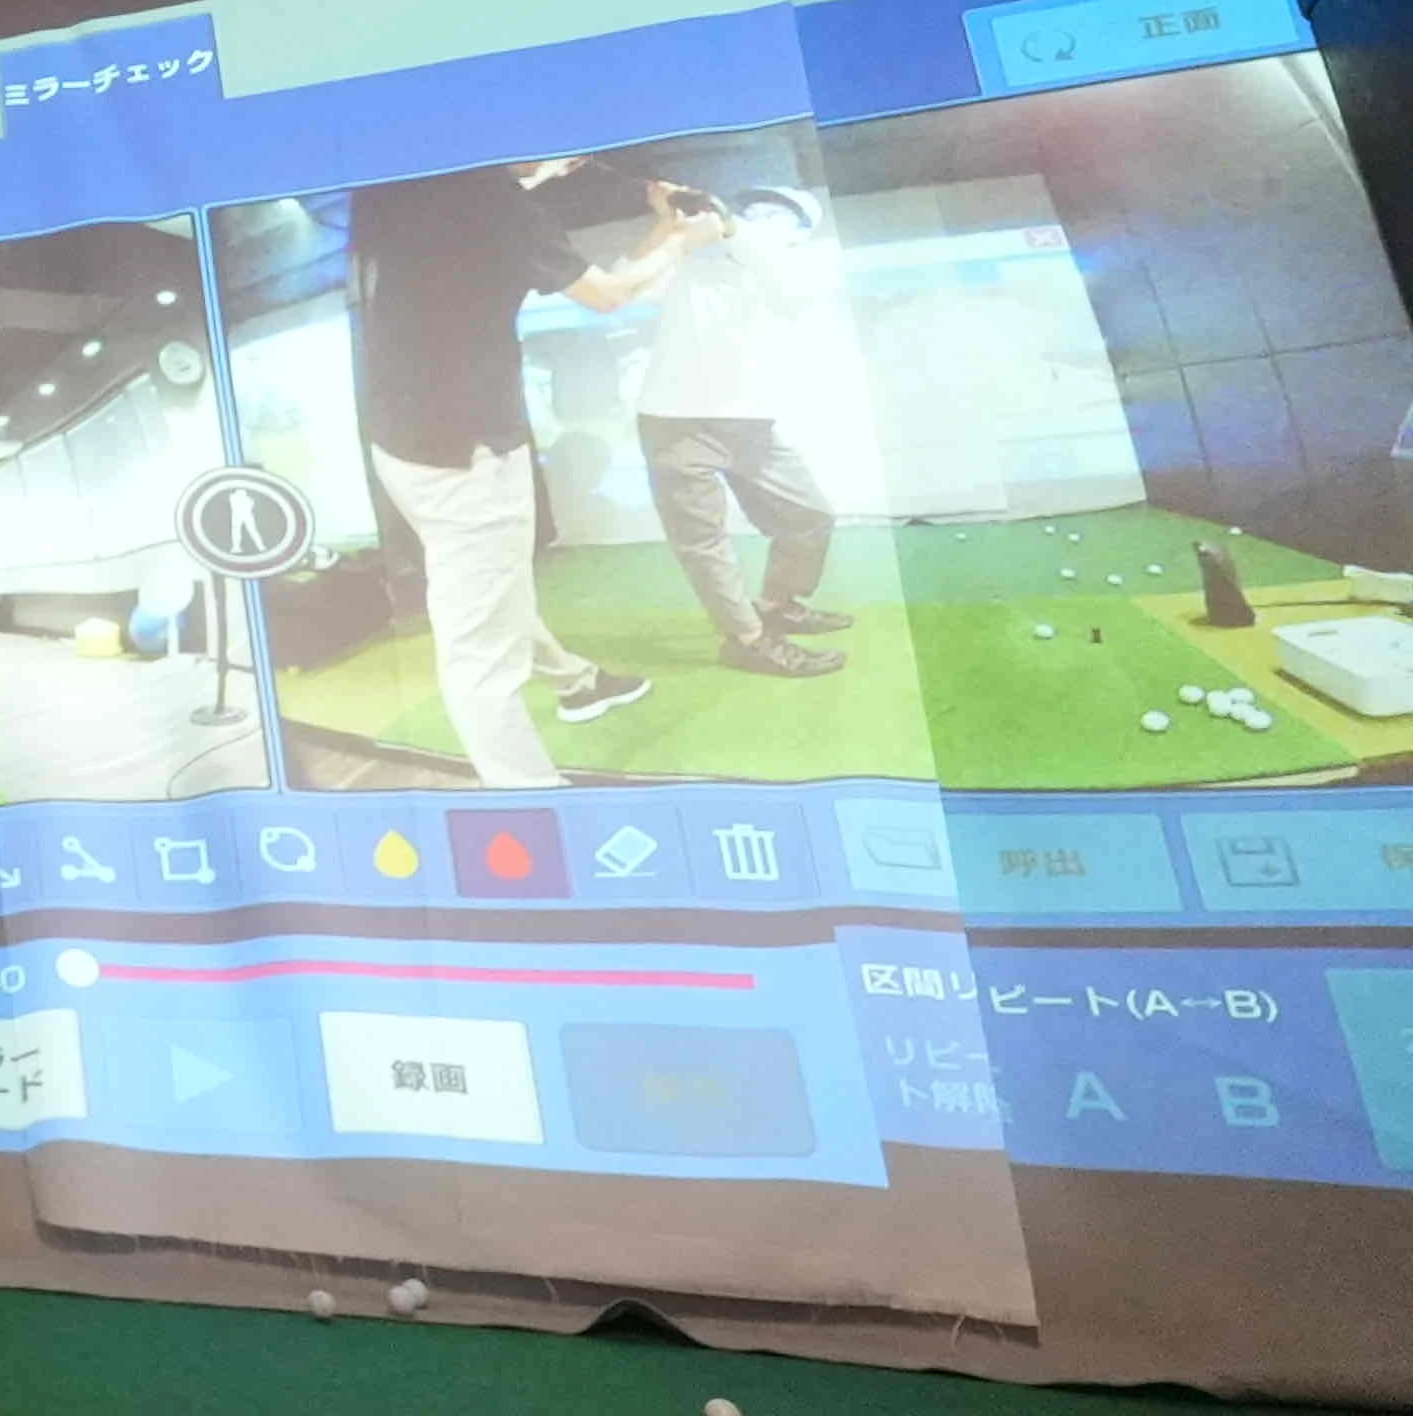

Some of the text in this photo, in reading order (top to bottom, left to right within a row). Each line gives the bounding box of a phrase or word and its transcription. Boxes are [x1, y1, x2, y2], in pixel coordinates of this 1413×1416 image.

[1139, 8, 1219, 39] 正面
[4, 48, 214, 106] ミラーチェック
[391, 1059, 469, 1096] 録画
[1065, 1070, 1127, 1121] A
[1214, 1075, 1281, 1128] B
